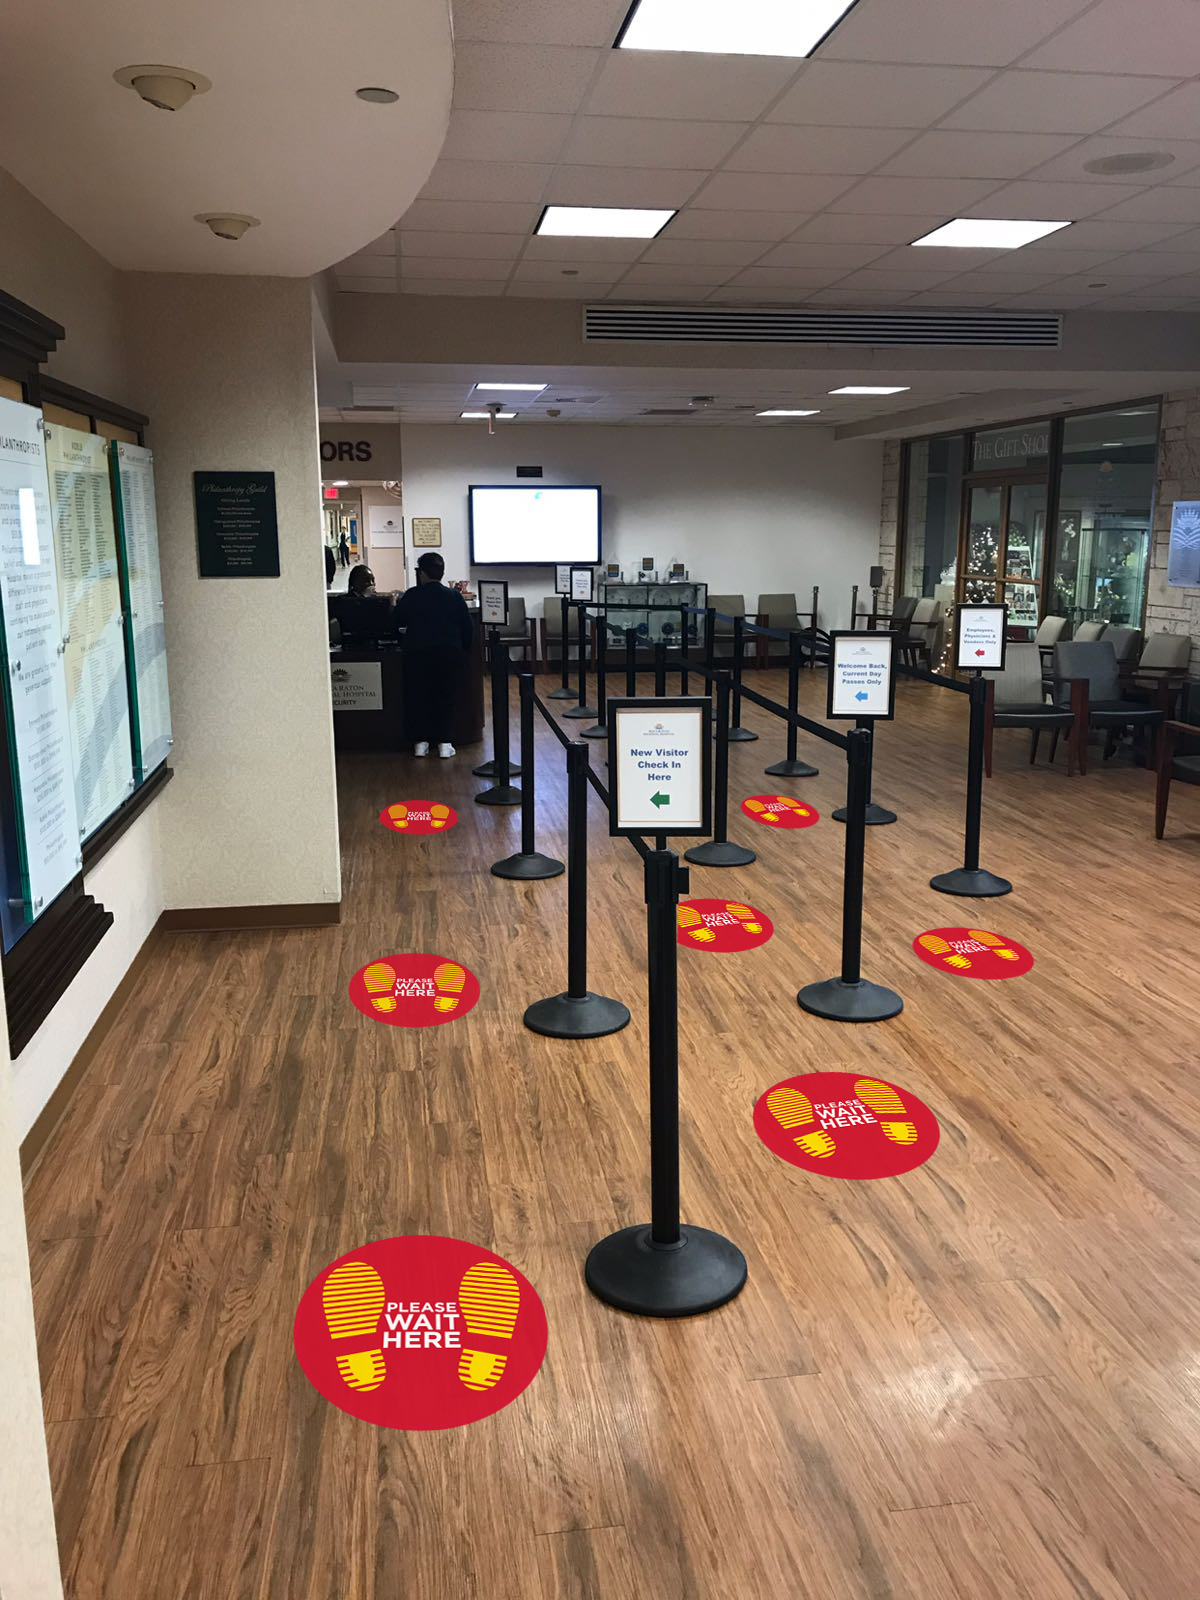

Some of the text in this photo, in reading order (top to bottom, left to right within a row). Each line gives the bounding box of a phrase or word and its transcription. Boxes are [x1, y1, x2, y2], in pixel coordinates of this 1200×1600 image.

[975, 440, 992, 460] THE
[994, 437, 1018, 458] GIFT
[630, 748, 689, 757] New Visitor
[637, 761, 682, 769] Check In
[647, 773, 672, 781] Here
[702, 913, 733, 922] WAIT
[705, 919, 740, 927] HERE
[396, 982, 435, 990] WAIT
[394, 989, 436, 997] HERE
[813, 1099, 862, 1110] PLEASE
[815, 1105, 867, 1119] WAIT
[820, 1113, 878, 1130] HERE
[387, 1302, 457, 1313] PLEASE
[384, 1313, 460, 1331] WAIT
[382, 1331, 462, 1349] HERE
